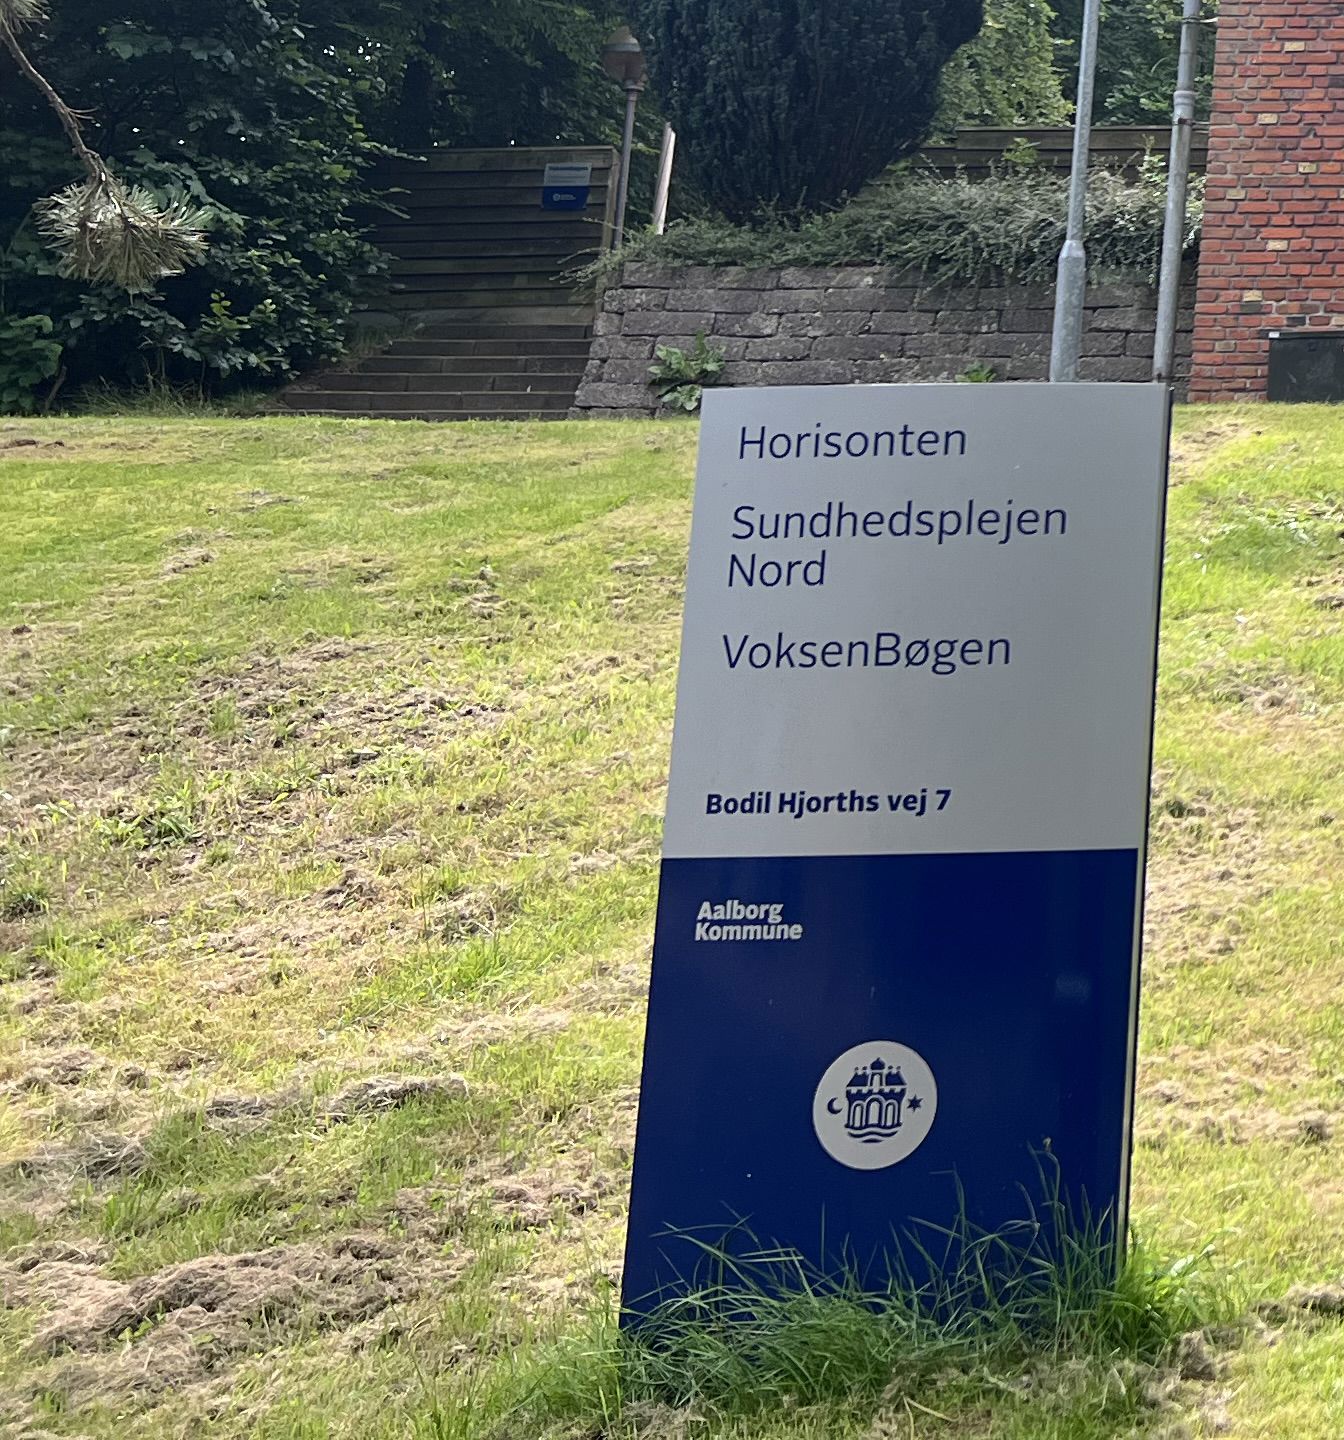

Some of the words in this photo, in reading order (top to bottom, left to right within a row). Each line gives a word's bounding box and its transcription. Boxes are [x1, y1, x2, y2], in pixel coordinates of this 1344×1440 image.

[740, 422, 966, 460] Horisonten
[731, 499, 1067, 545] Sundhedsplejen
[728, 550, 826, 587] Nord
[722, 632, 1011, 676] VoksenBøgen
[705, 791, 772, 815] Bodil
[778, 789, 880, 819] Hjorths
[887, 788, 928, 817] vej
[935, 789, 952, 811] 7
[697, 899, 784, 924] Aalborg
[695, 921, 803, 942] Kommune
